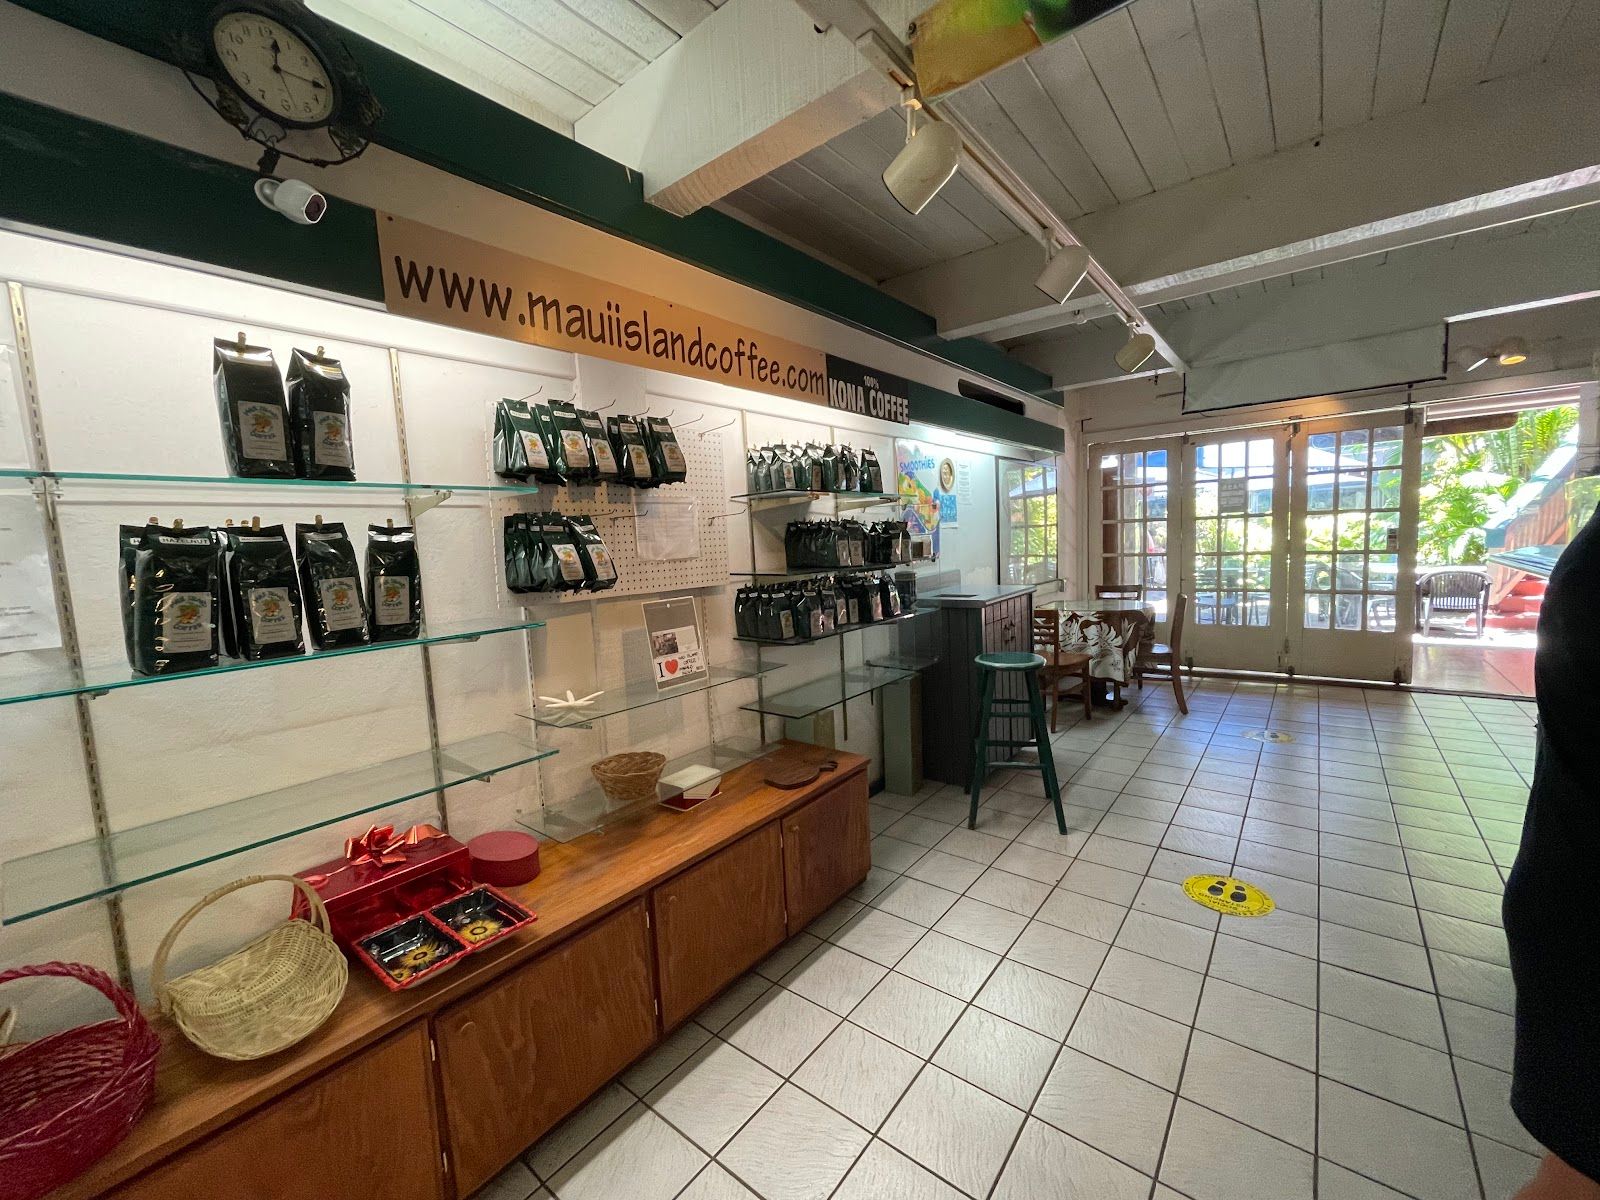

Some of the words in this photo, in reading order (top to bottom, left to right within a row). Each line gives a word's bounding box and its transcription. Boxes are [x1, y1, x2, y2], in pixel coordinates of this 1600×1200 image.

[258, 26, 273, 37] 12
[258, 88, 266, 100] 7
[394, 255, 825, 397] www.mauiislandcoffee.com
[863, 375, 880, 390] 100%
[829, 377, 866, 414] KONA
[869, 389, 909, 424] COFFEE
